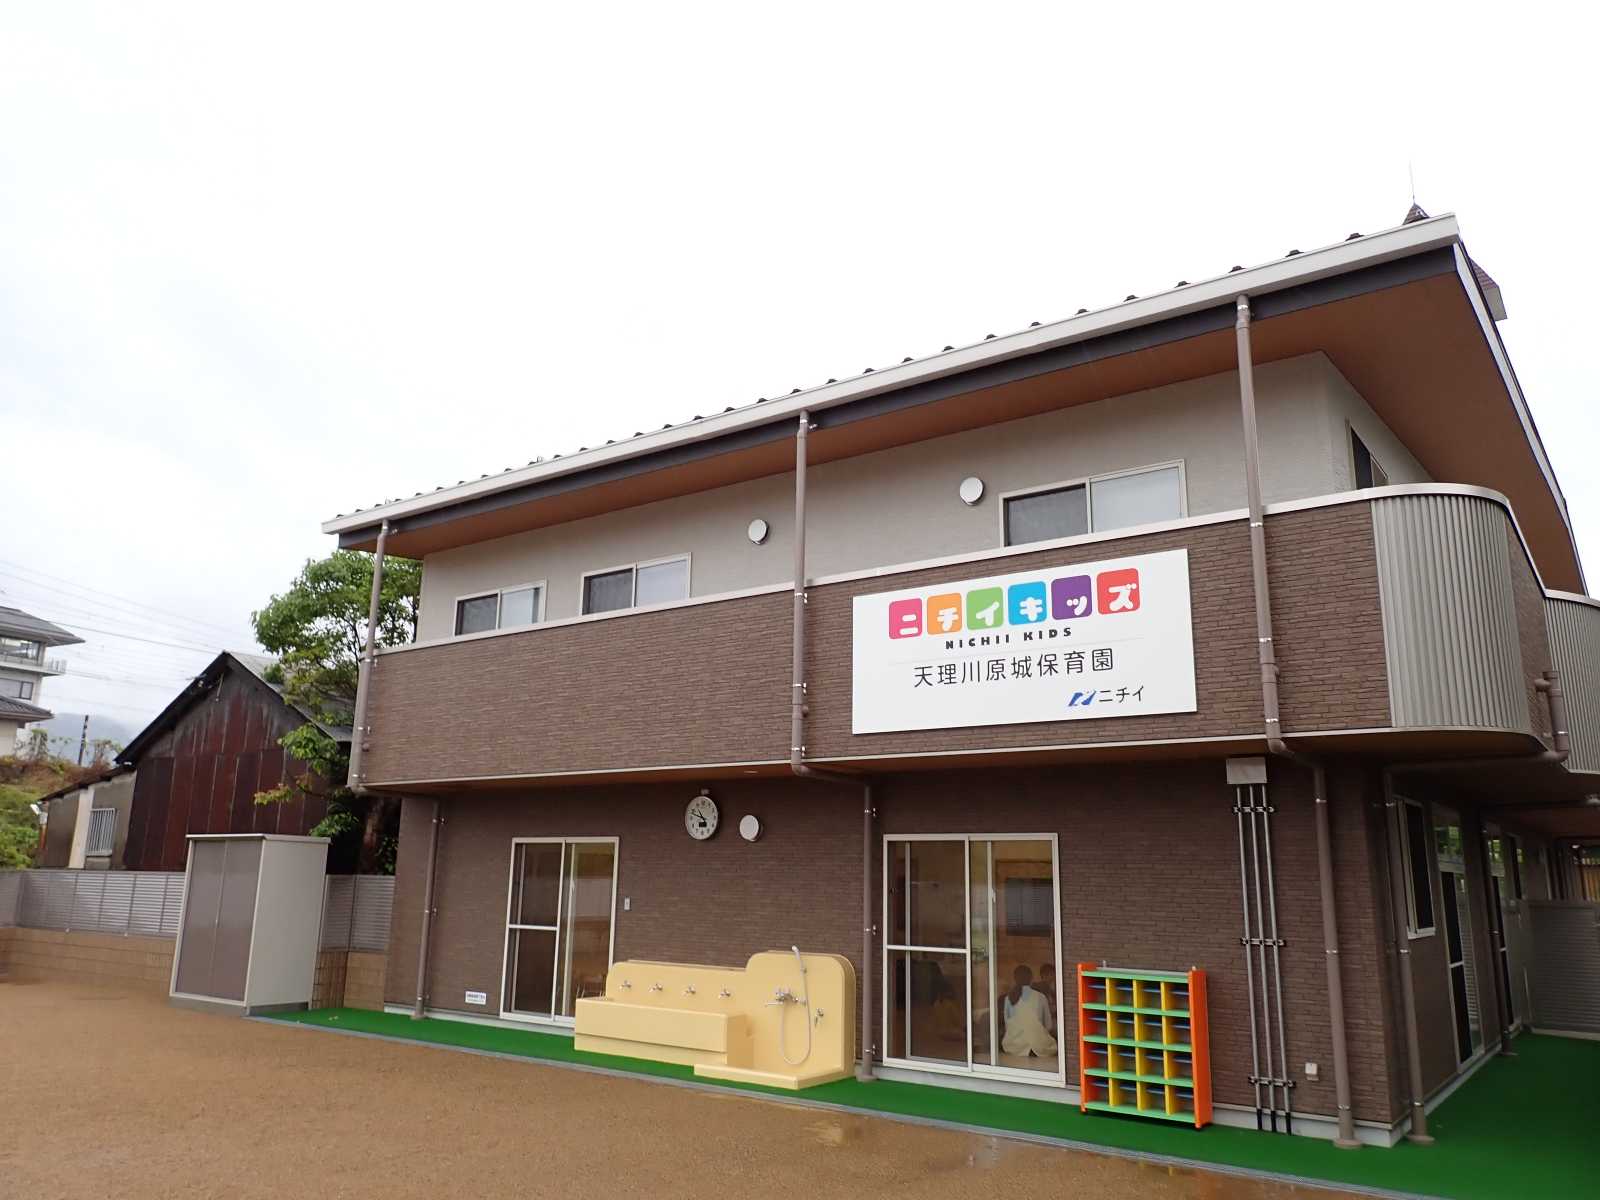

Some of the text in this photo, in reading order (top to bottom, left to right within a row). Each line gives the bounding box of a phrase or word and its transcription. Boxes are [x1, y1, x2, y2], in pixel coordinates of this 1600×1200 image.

[899, 582, 1137, 636] ニチイキッズ
[945, 627, 1072, 649] NICHII KIDS
[913, 648, 1114, 688] 天理川原城保育園
[1098, 685, 1145, 704] ニチイ
